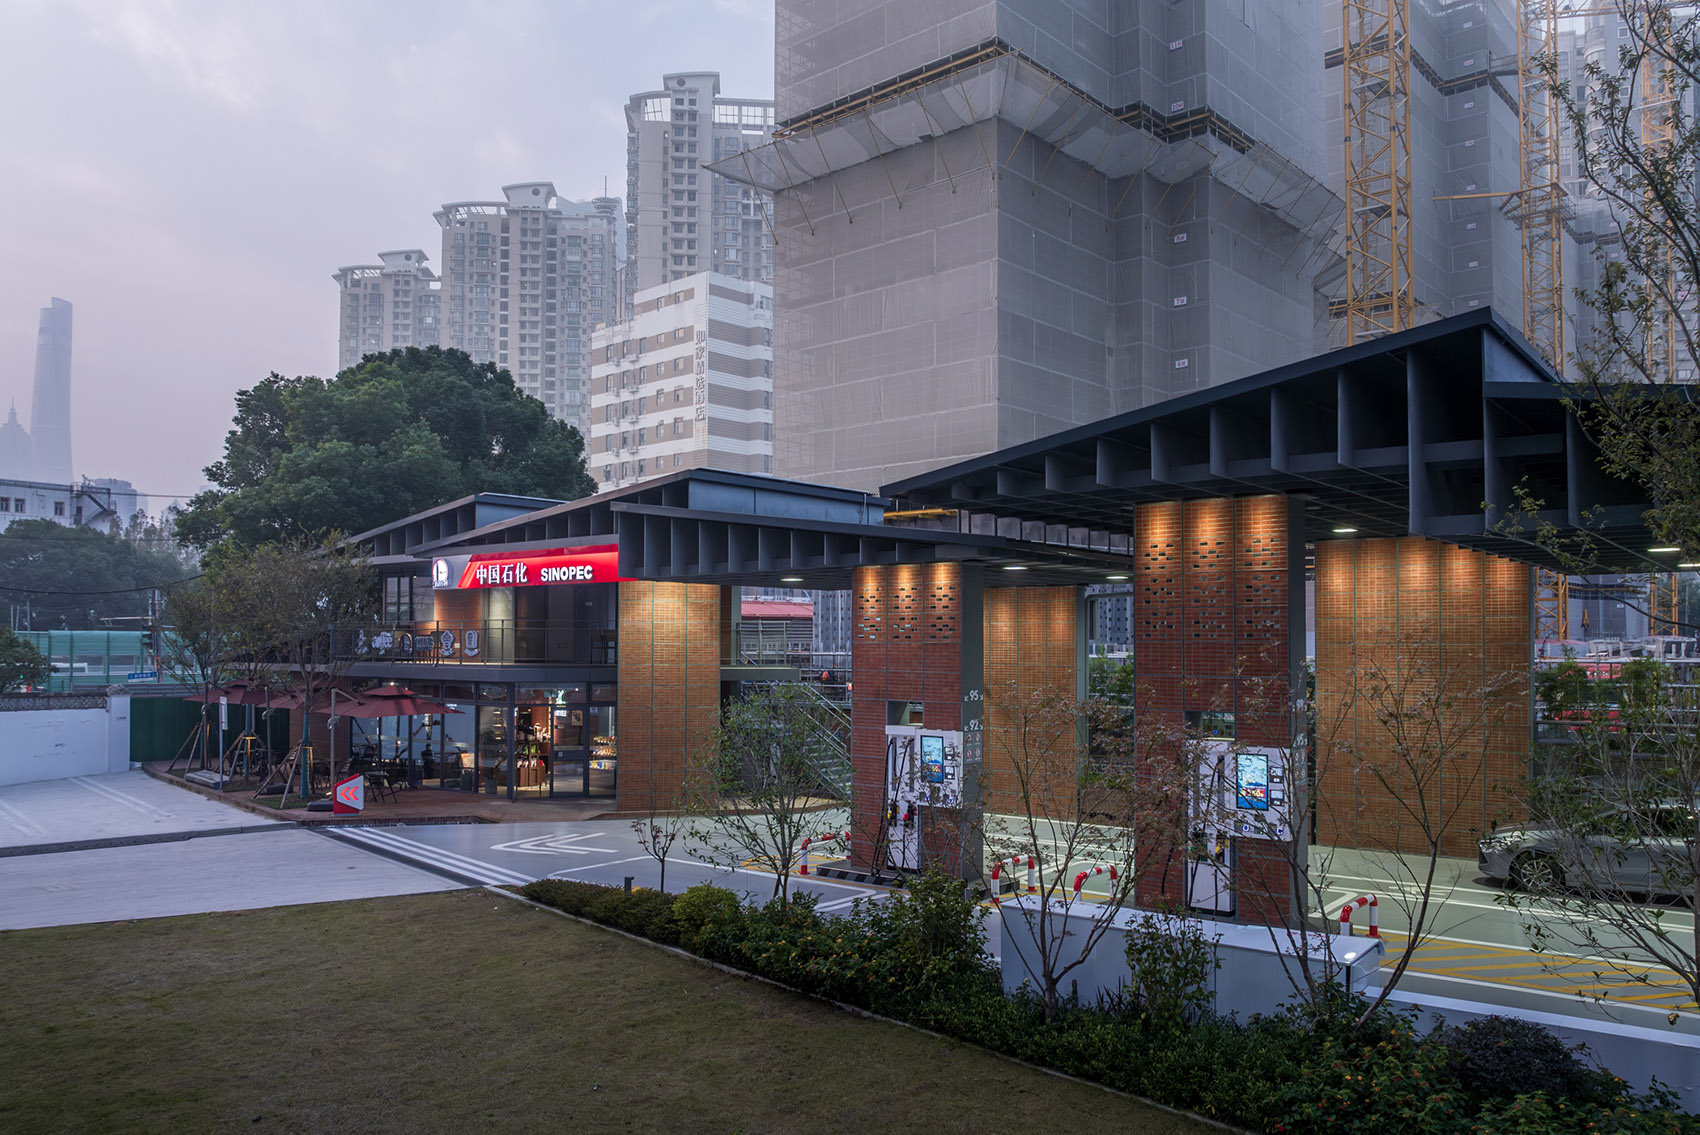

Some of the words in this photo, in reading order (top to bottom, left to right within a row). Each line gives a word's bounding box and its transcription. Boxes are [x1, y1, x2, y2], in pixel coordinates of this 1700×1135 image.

[476, 562, 528, 585] 中国石化
[540, 565, 593, 582] SINOPEC
[969, 689, 979, 701] 95
[969, 719, 979, 731] 92
